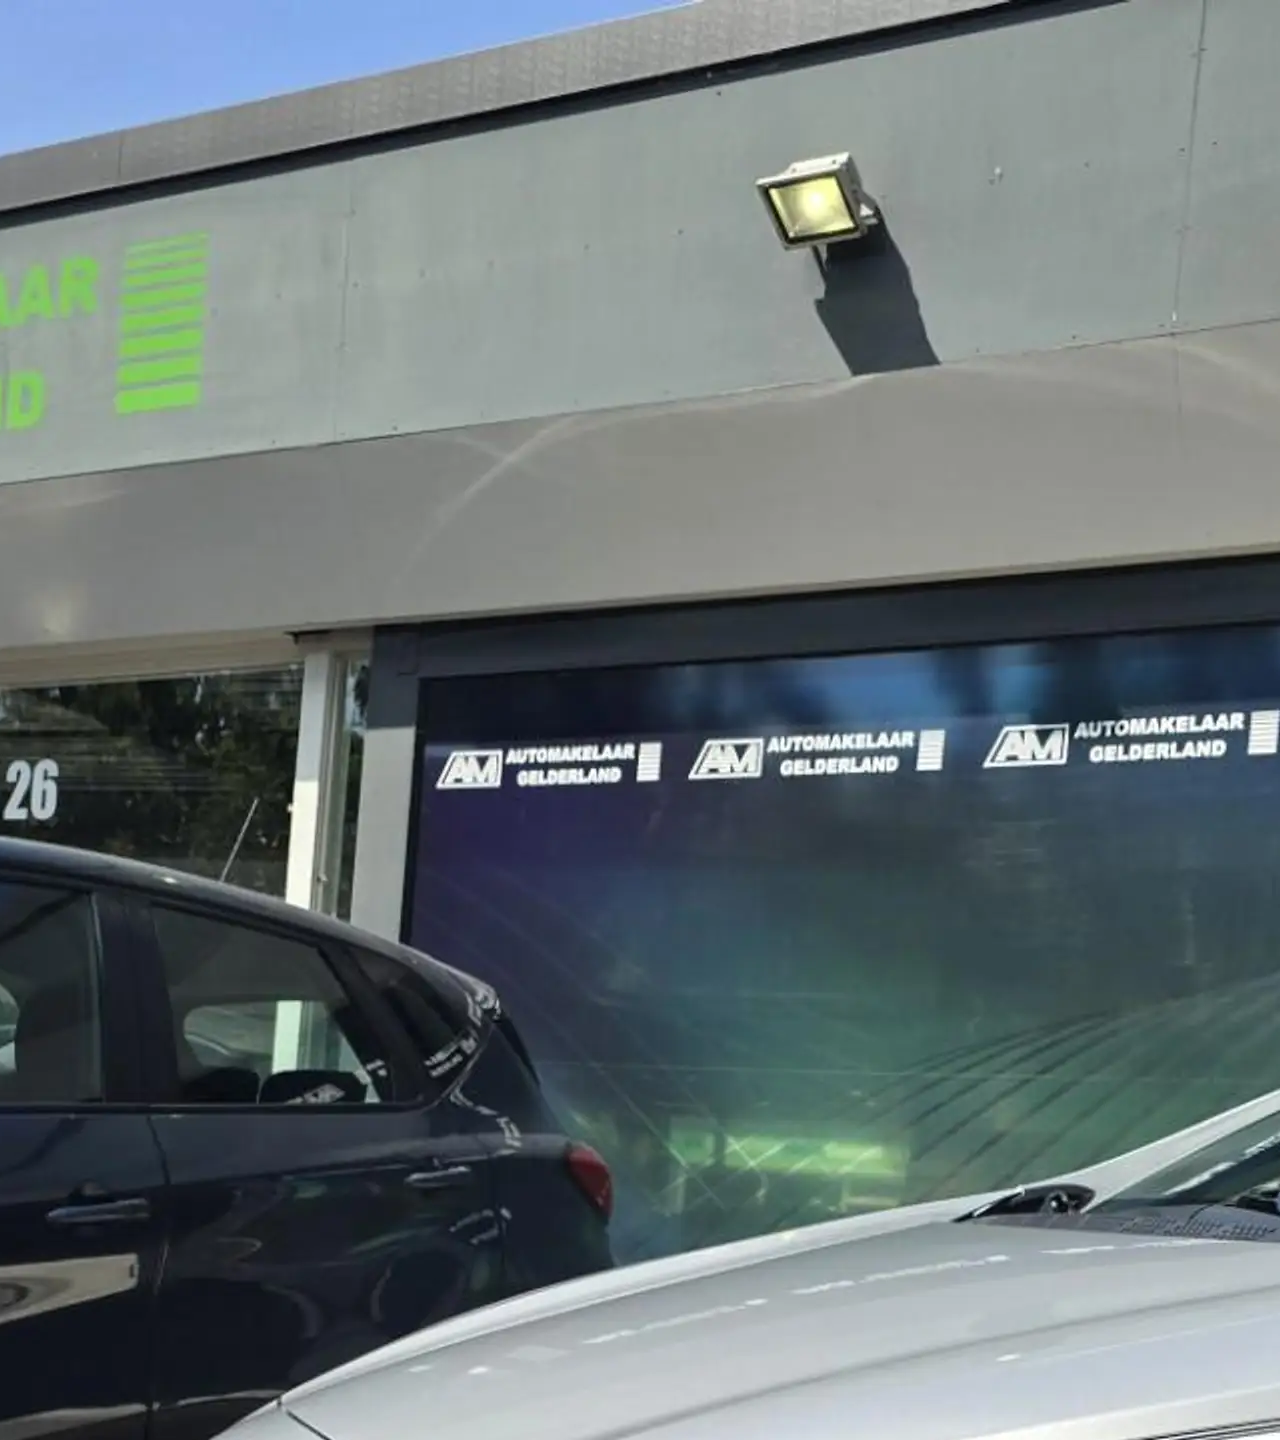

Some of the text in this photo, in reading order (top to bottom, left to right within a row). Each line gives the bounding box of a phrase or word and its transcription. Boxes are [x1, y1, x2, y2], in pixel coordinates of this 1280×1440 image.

[1073, 711, 1246, 740] AUTOMAKELAAR
[505, 742, 636, 765] AUTOMAKELAAR
[766, 730, 916, 754] AUTOMAKELAAR
[1088, 739, 1228, 764] GELDERLAND
[516, 766, 623, 787] GELDERLAND
[780, 754, 900, 777] GELDERLAND
[2, 757, 60, 821] 26
